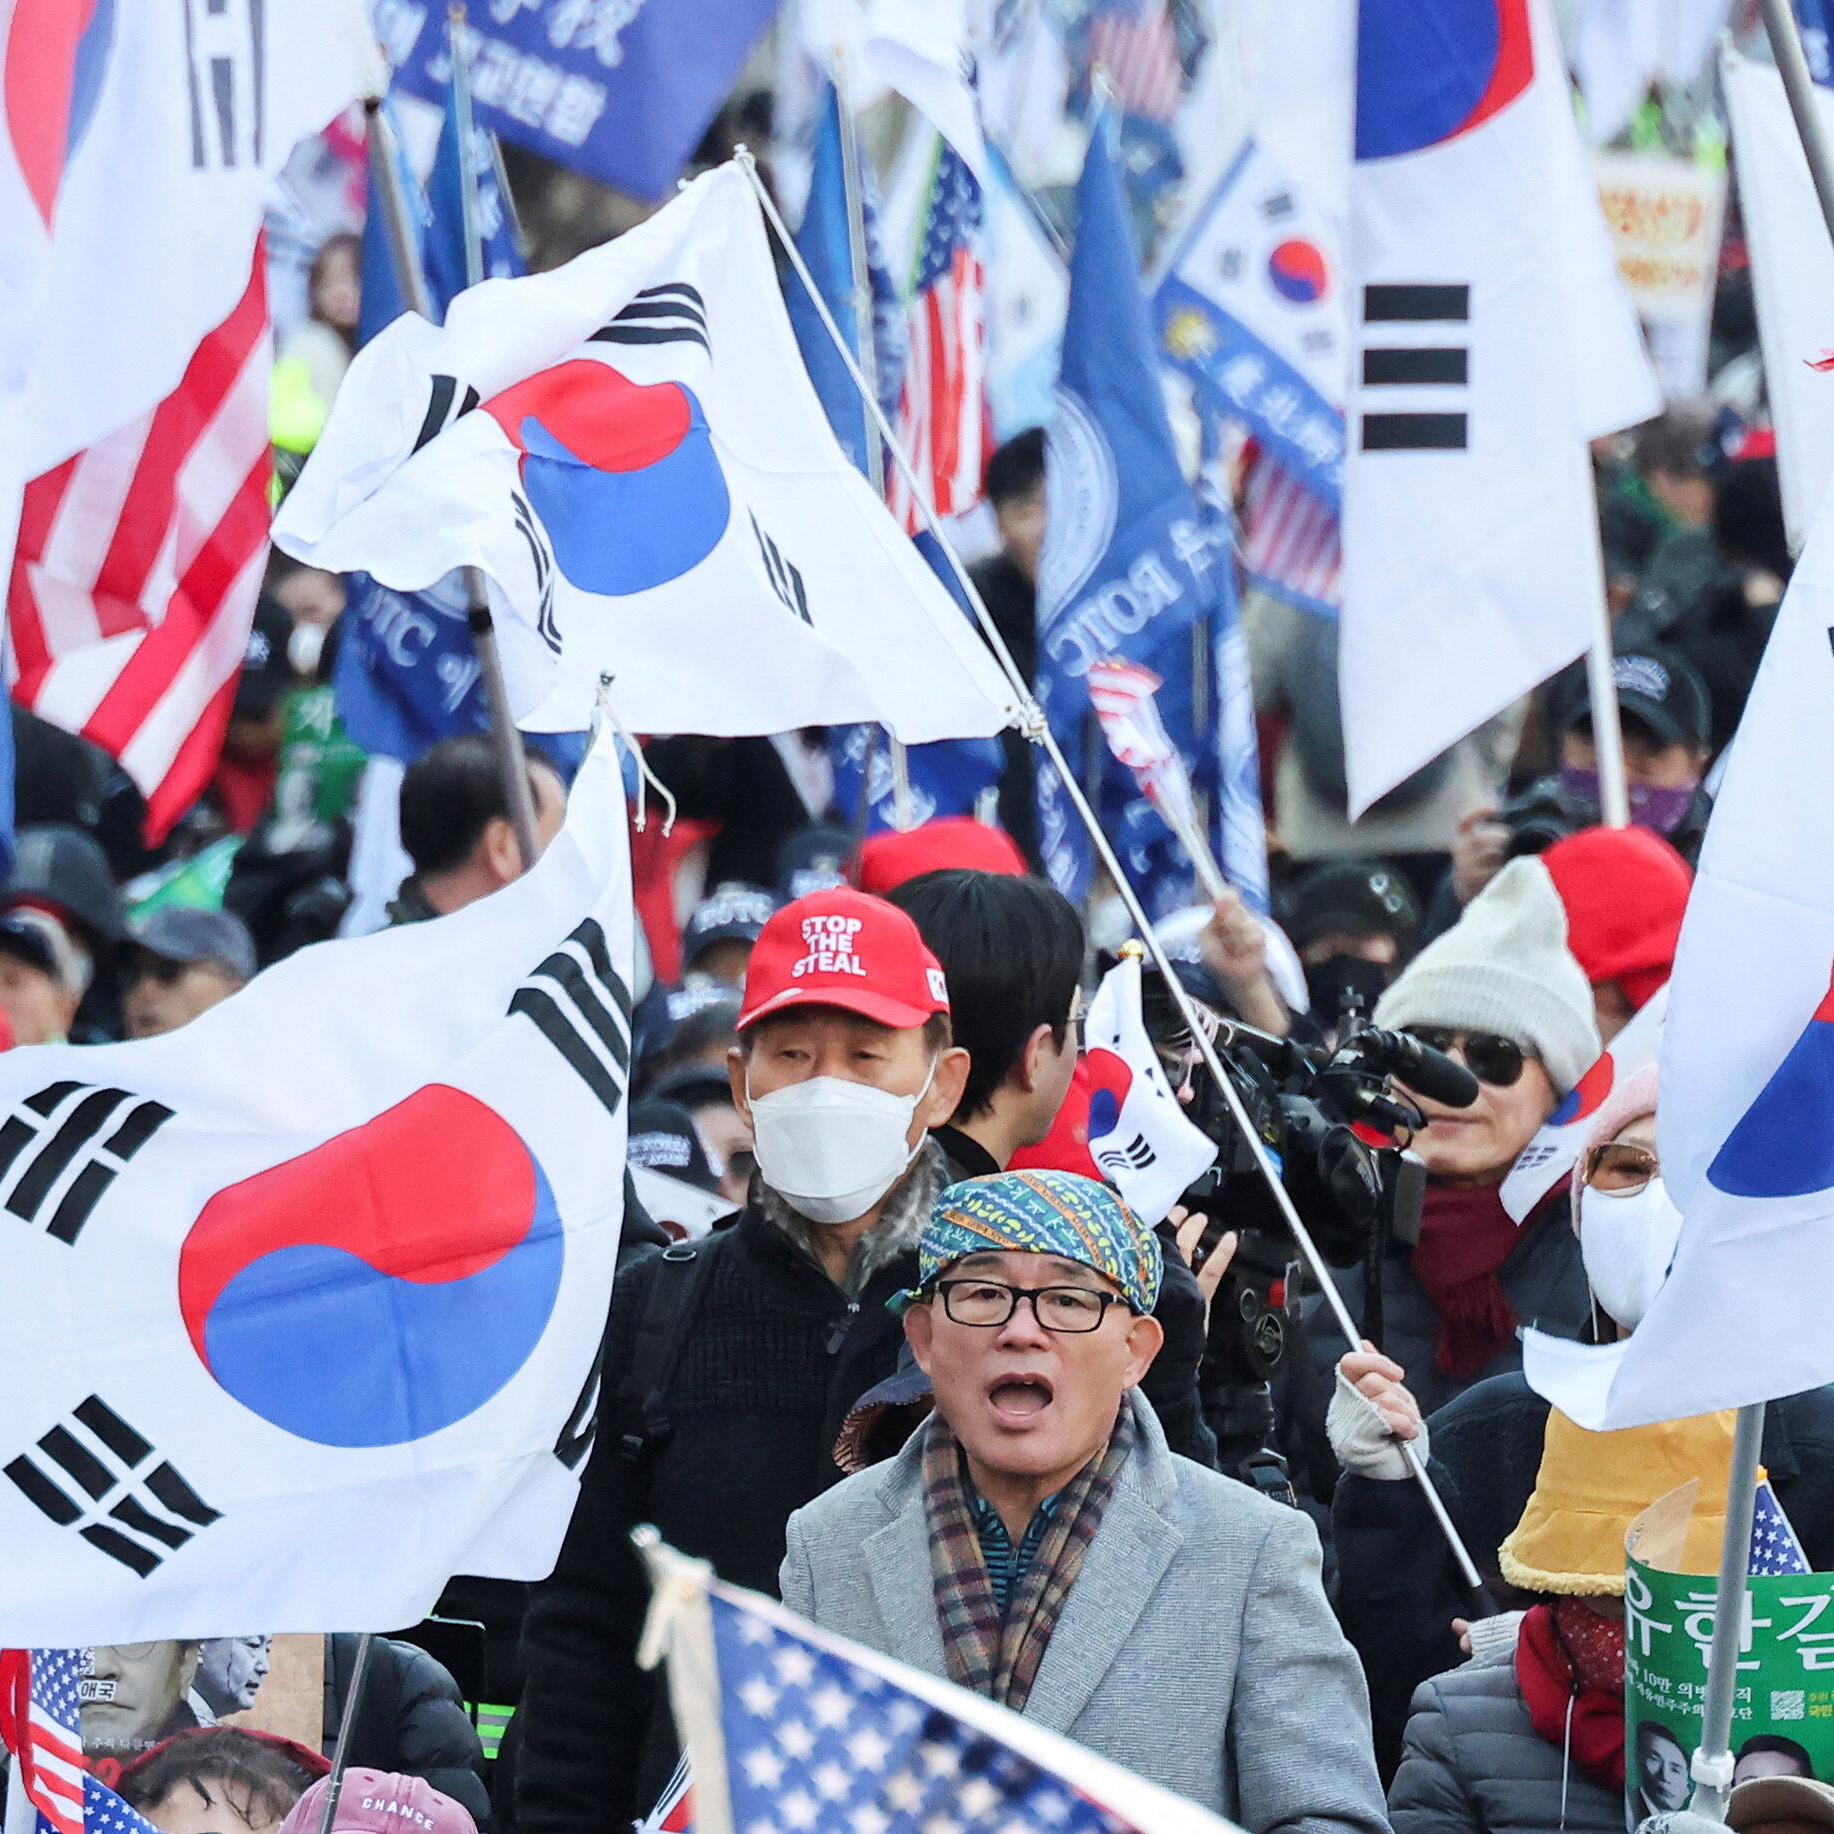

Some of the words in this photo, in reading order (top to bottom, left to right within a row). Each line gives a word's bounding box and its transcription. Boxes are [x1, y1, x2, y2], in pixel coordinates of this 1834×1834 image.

[801, 915, 863, 938] STOP
[805, 933, 854, 954] THE
[791, 951, 867, 978] STEAL
[79, 1678, 116, 1702] 애국
